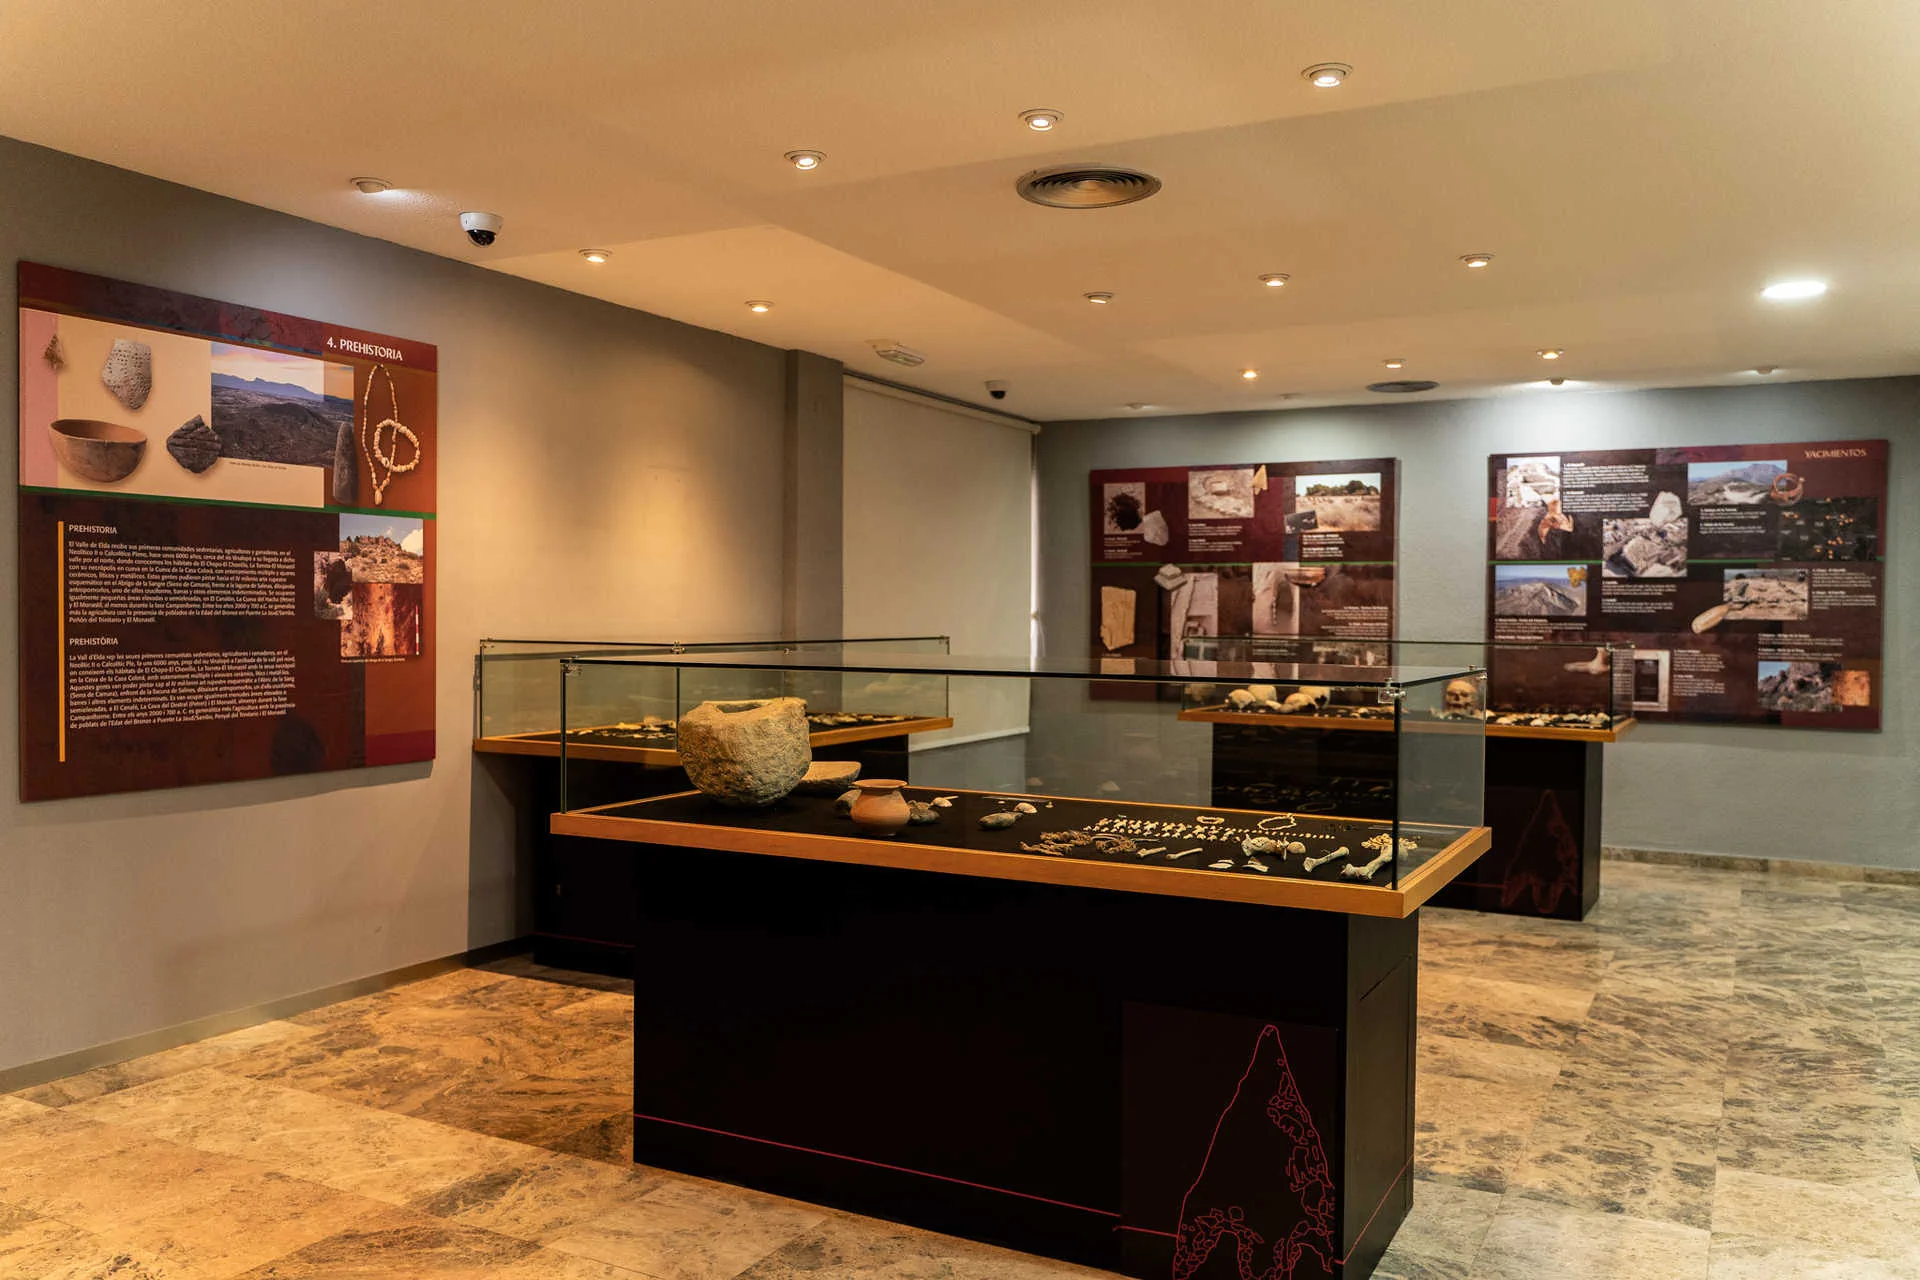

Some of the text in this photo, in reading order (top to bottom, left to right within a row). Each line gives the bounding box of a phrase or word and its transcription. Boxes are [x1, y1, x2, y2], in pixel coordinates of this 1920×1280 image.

[326, 336, 403, 360] 4. PREHISTORIA
[1804, 448, 1867, 459] YACIMIENTOS
[68, 524, 118, 534] PREHISTORIA
